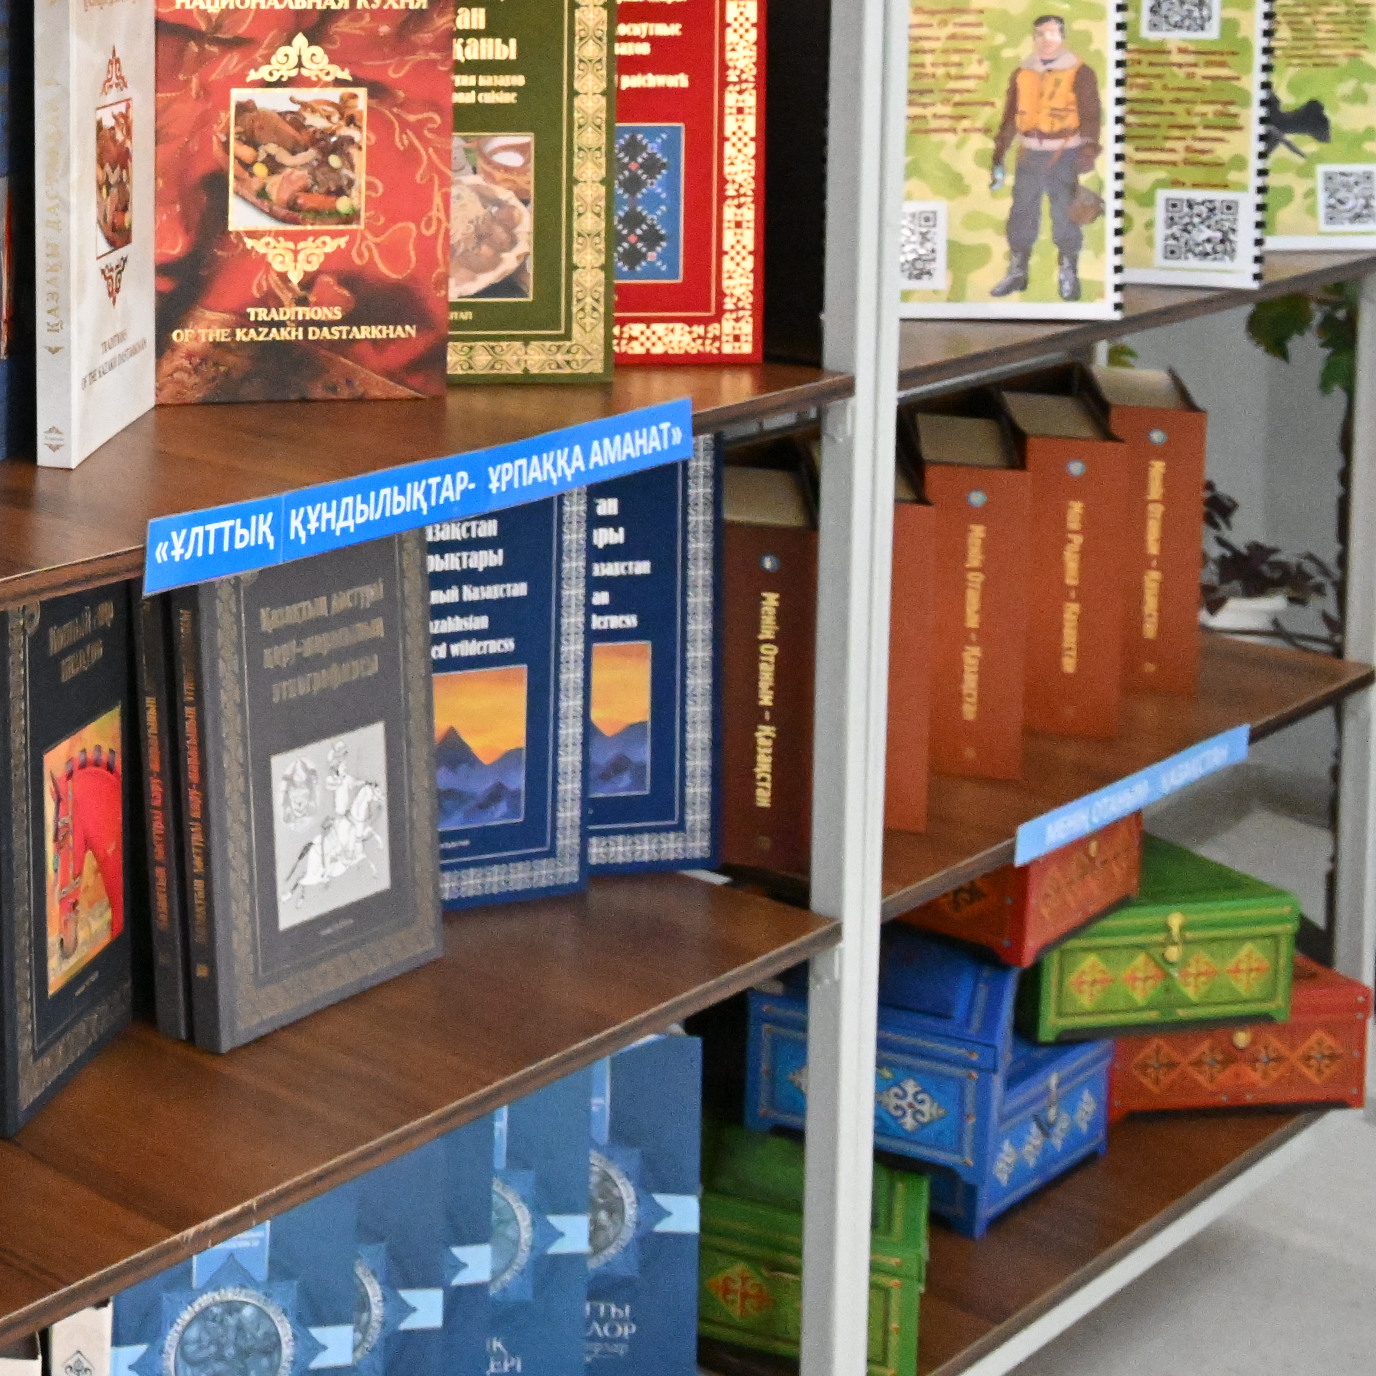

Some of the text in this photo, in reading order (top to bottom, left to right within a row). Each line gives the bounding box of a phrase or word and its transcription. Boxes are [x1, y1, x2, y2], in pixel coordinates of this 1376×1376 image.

[172, 322, 417, 343] OF THE KAZAKH DASTARKHAN
[247, 305, 342, 323] TRADITIONS
[154, 423, 683, 564] «ҰЛТТЫҚ ҚҰНДЫЛЫҚТАР- ҰРПАҚҚА АМАНАТ»
[754, 592, 780, 808] Менің Отаным Қазақстан
